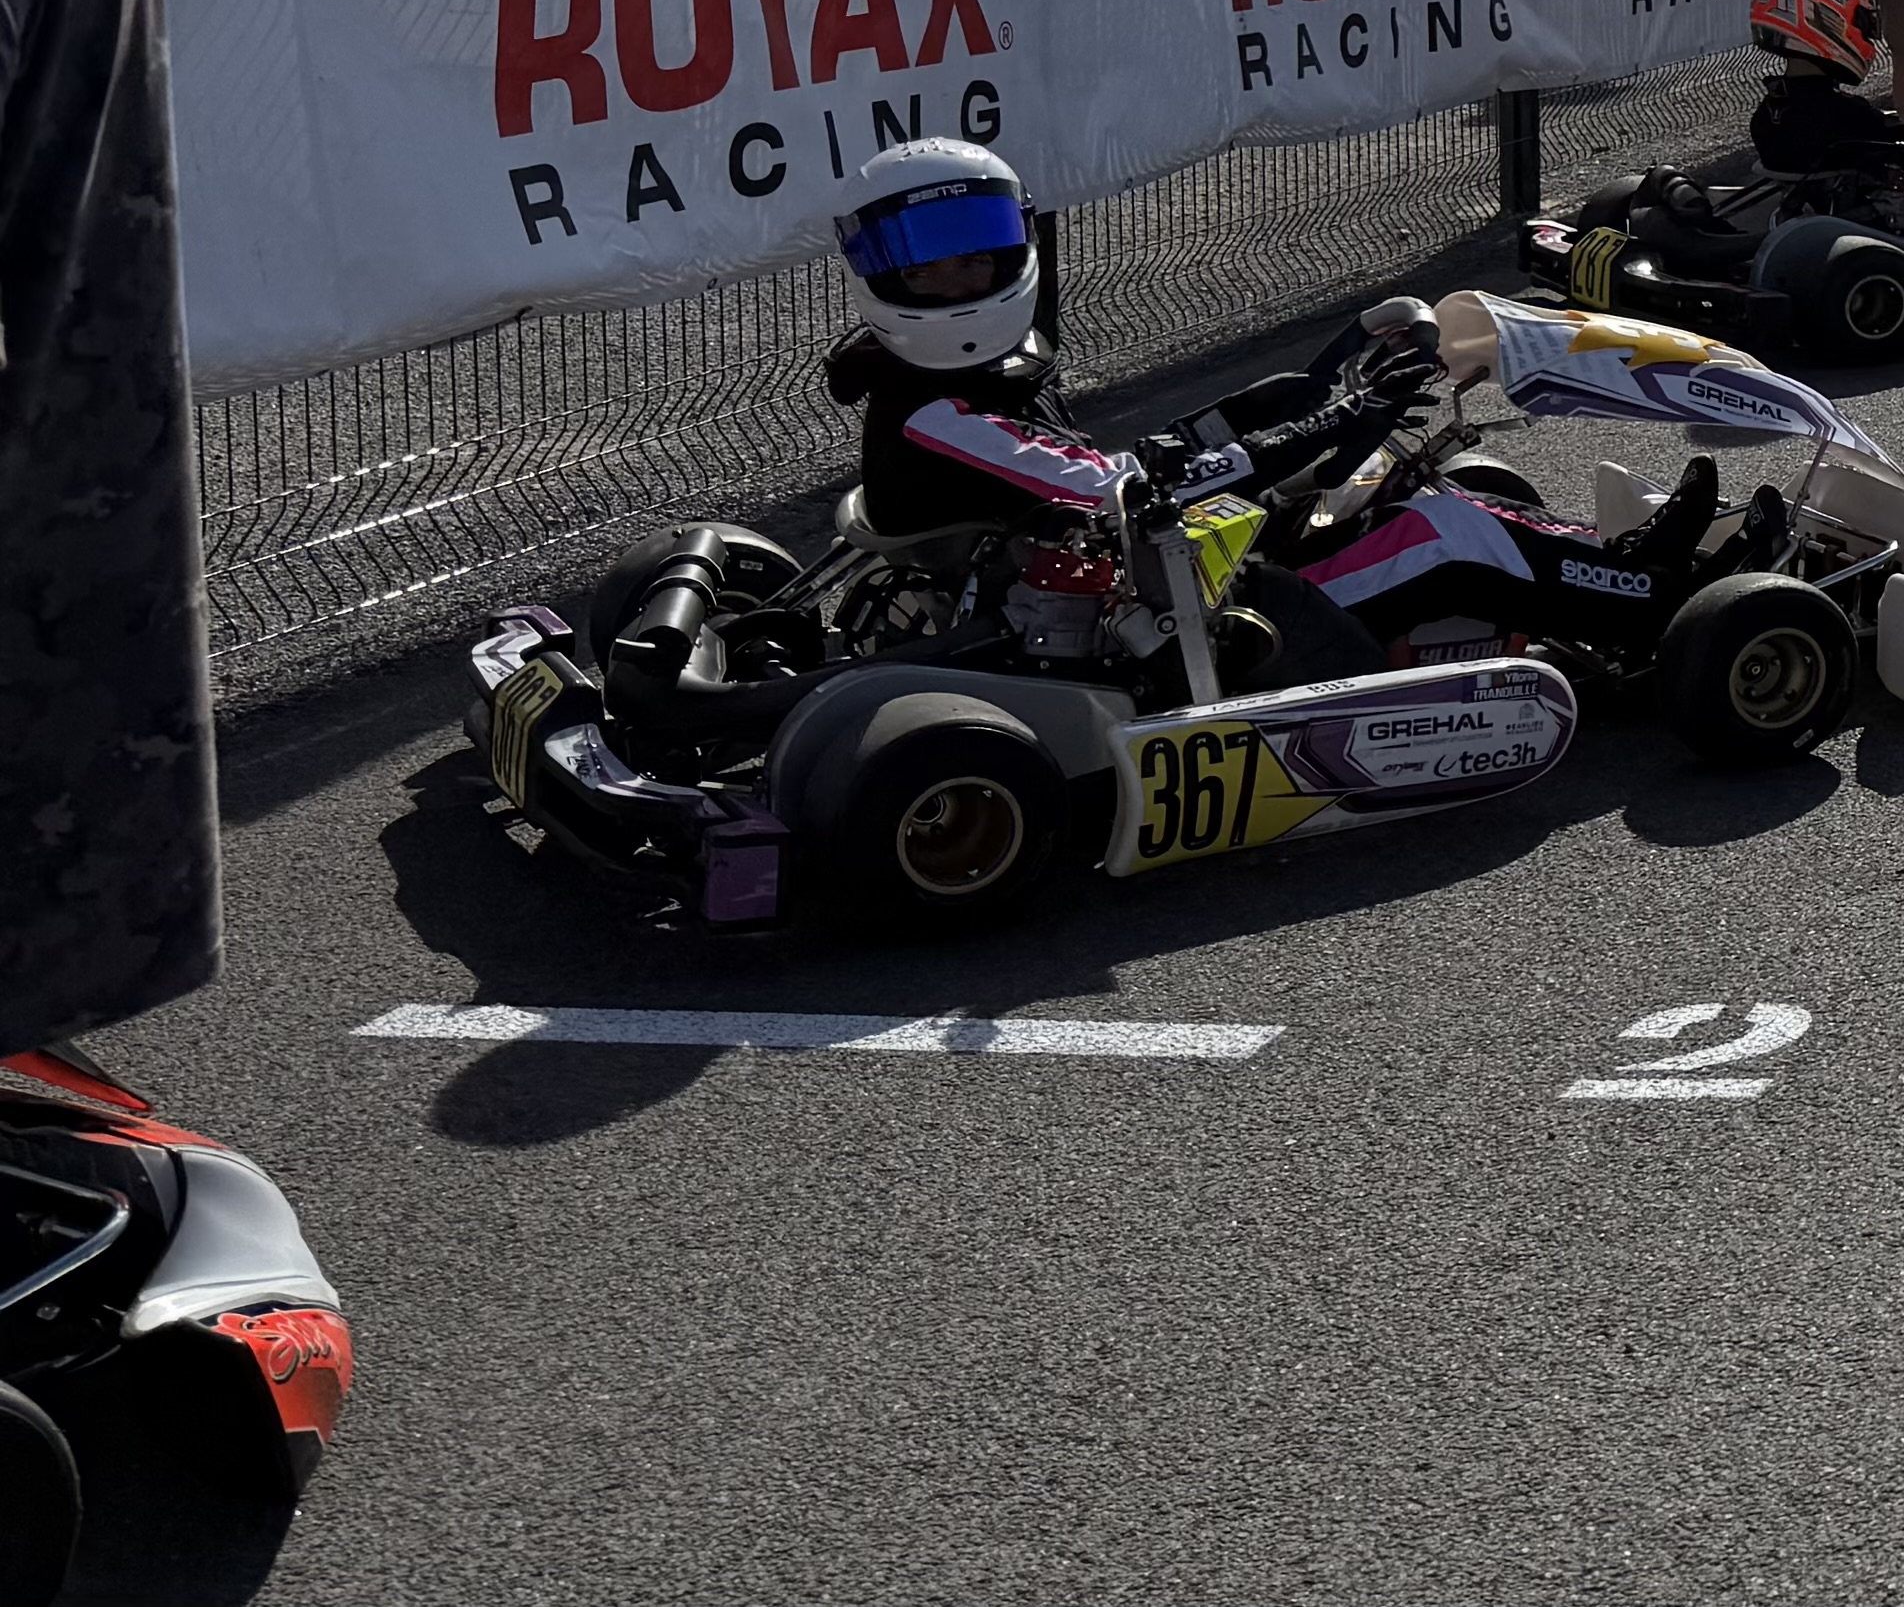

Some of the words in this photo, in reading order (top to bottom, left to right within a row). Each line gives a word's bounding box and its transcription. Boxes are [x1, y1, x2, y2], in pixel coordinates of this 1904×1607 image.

[509, 80, 1002, 245] RACING
[1687, 381, 1792, 423] GREHAL
[1560, 558, 1652, 594] sparco
[1473, 683, 1540, 702] TRANQUILLE
[1368, 712, 1494, 741] GREHAL
[1460, 742, 1537, 775] tec3h
[1138, 730, 1262, 859] 367
